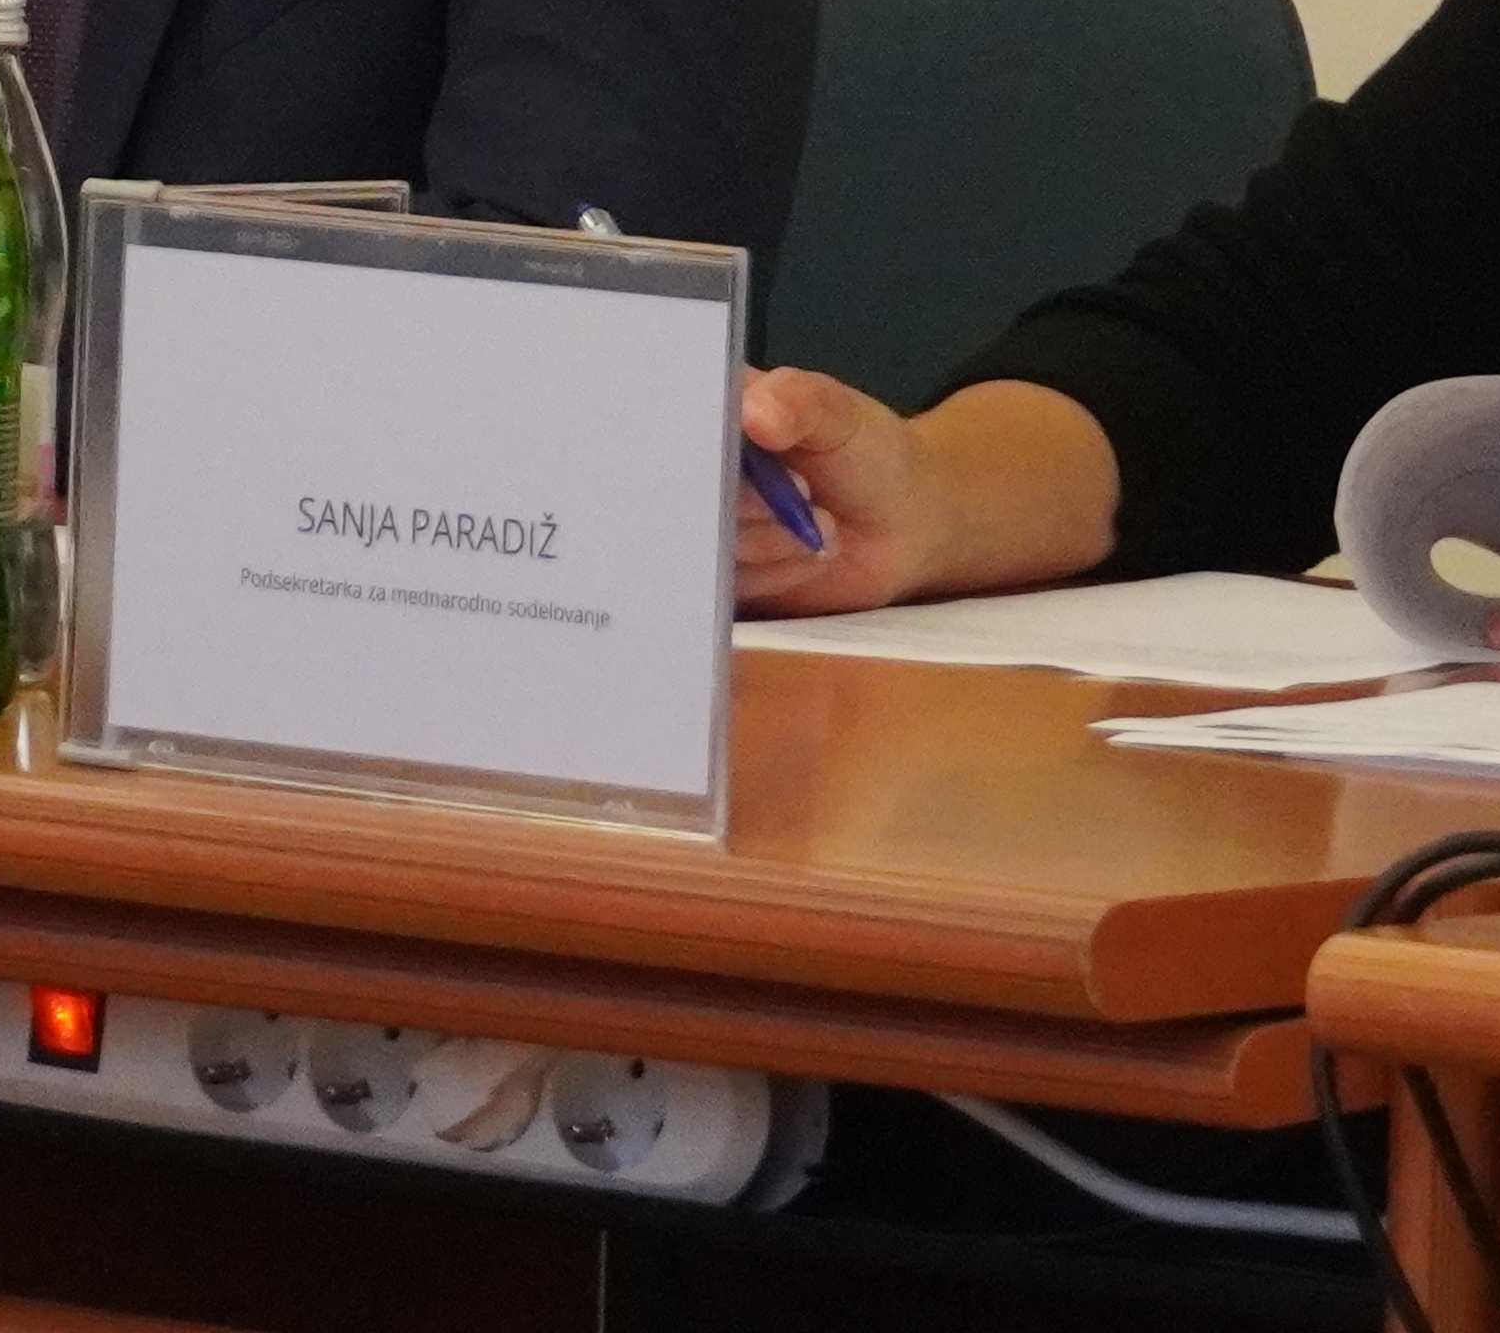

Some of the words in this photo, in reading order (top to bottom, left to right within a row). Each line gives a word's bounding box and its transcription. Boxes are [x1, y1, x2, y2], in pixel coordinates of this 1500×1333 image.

[297, 496, 400, 548] SANJA
[412, 507, 559, 560] PARADIŽ
[240, 567, 363, 600] Podsekretarka
[368, 584, 386, 603] za
[391, 585, 502, 616] mednarodno
[507, 599, 612, 632] sodelovanje
